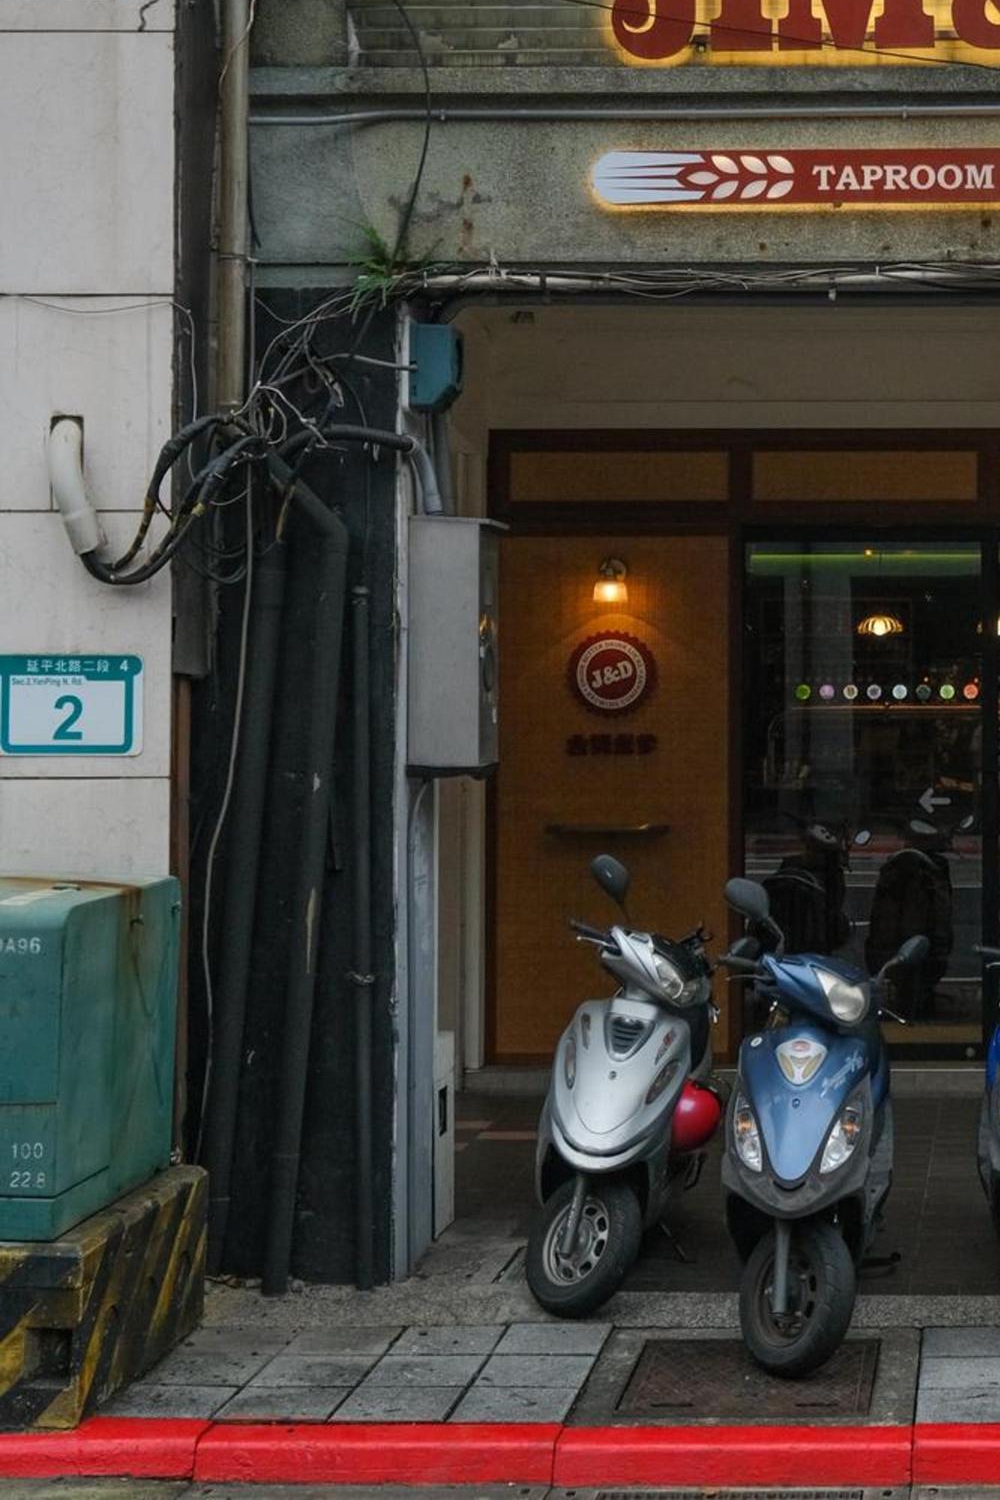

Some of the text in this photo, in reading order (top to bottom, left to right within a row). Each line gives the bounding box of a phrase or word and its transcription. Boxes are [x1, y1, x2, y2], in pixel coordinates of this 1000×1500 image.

[812, 164, 995, 191] TAPROOM
[26, 659, 129, 673] 延平北路二段 4
[591, 660, 633, 688] J&D
[52, 695, 83, 740] 2
[0, 937, 41, 954] A96
[12, 1142, 44, 1159] 100
